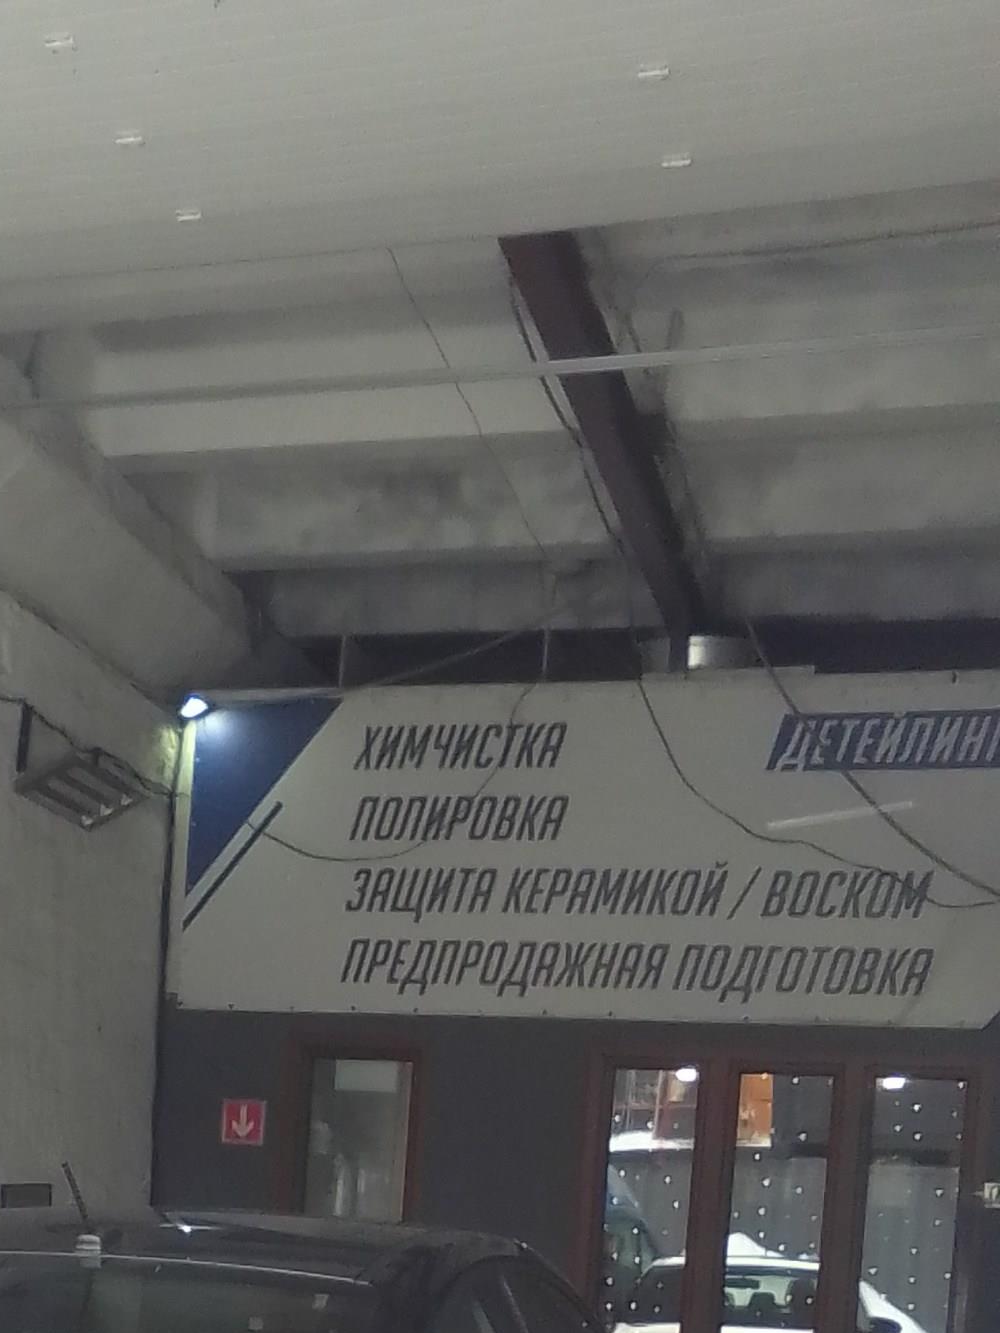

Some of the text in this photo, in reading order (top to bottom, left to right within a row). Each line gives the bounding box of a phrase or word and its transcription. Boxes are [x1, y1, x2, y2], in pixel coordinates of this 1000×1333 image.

[352, 721, 568, 772] ХИМЧИСТКА
[349, 795, 569, 842] ПОЛИРОВКА
[344, 867, 492, 923] ЗАЩИТА
[500, 861, 729, 919] КЕРАМИКОЙ
[761, 870, 933, 920] ВОСКОМ
[340, 938, 936, 1003] ПРЕДПРОДАЖНАЯ ПОДГОТОВКА
